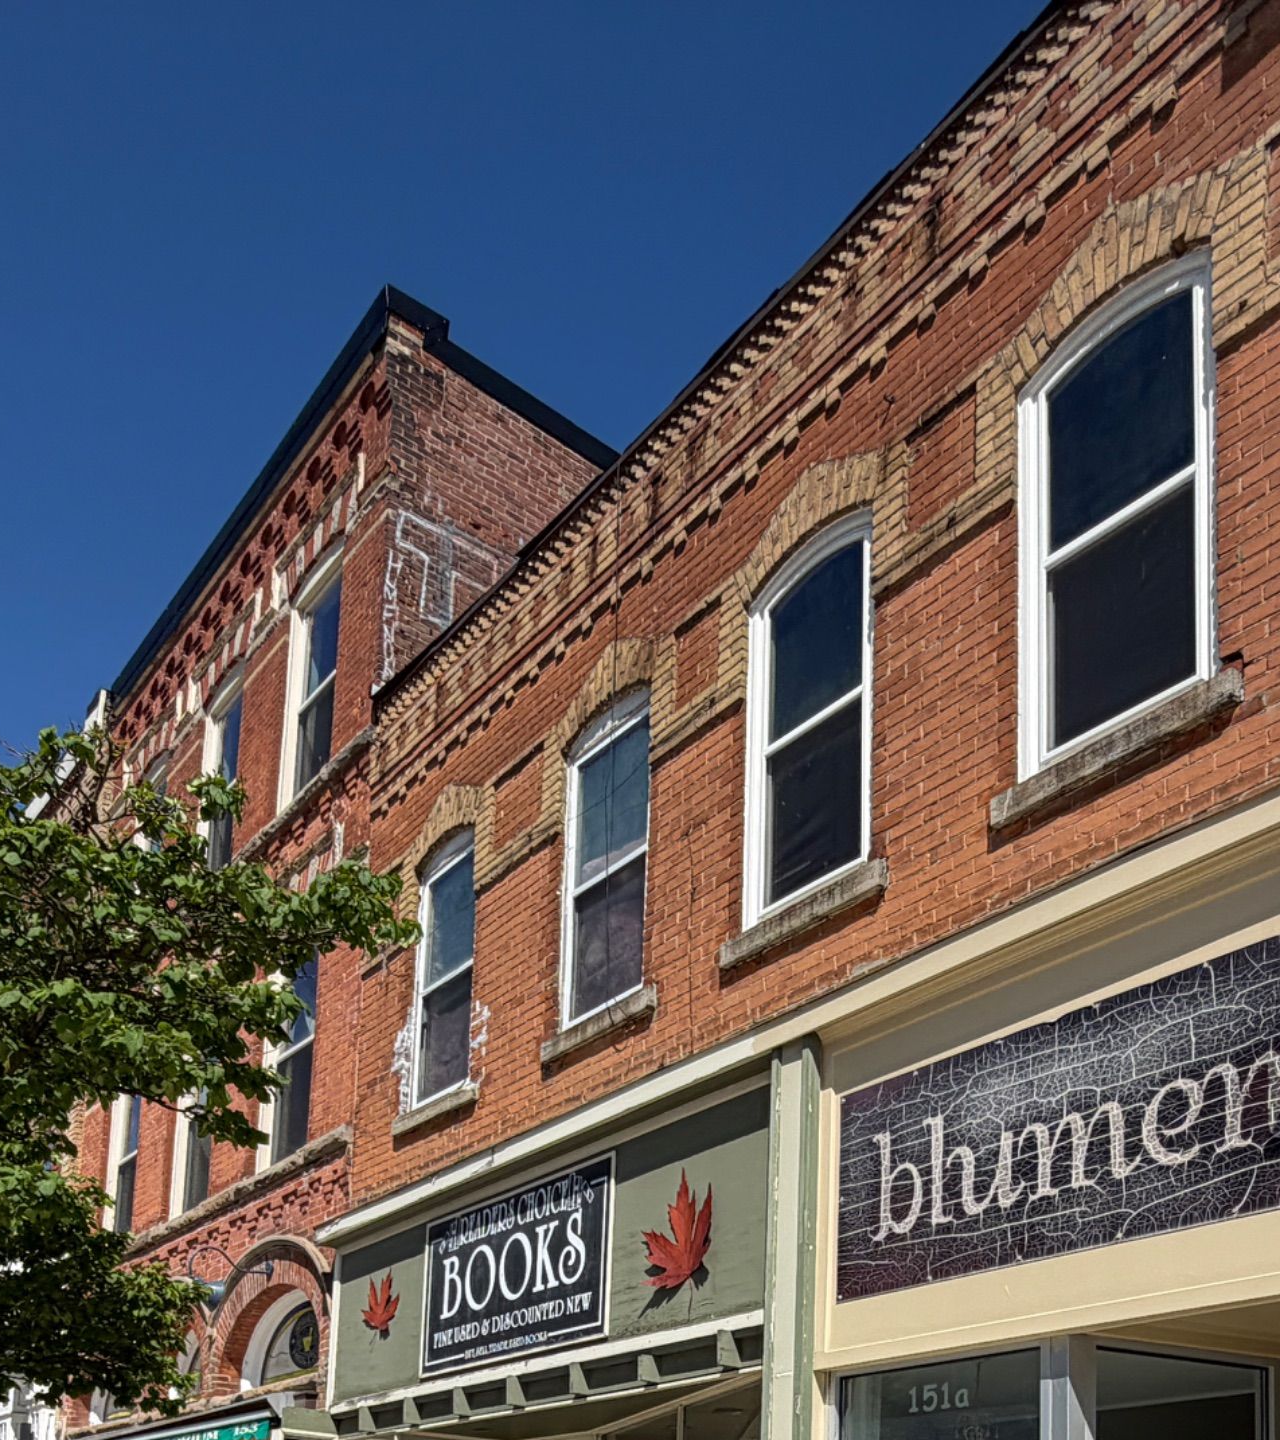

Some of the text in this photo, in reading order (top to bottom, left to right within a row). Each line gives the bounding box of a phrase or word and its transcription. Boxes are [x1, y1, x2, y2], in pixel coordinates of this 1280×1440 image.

[517, 1179, 570, 1226] CHOICE
[439, 1208, 586, 1321] BOOKS
[433, 1328, 454, 1349] FINE
[454, 1322, 480, 1344] USED
[491, 1299, 565, 1334] DISCOUNTED
[566, 1292, 593, 1315] NEW
[907, 1382, 970, 1414] 151a
[233, 1423, 259, 1437] 153
